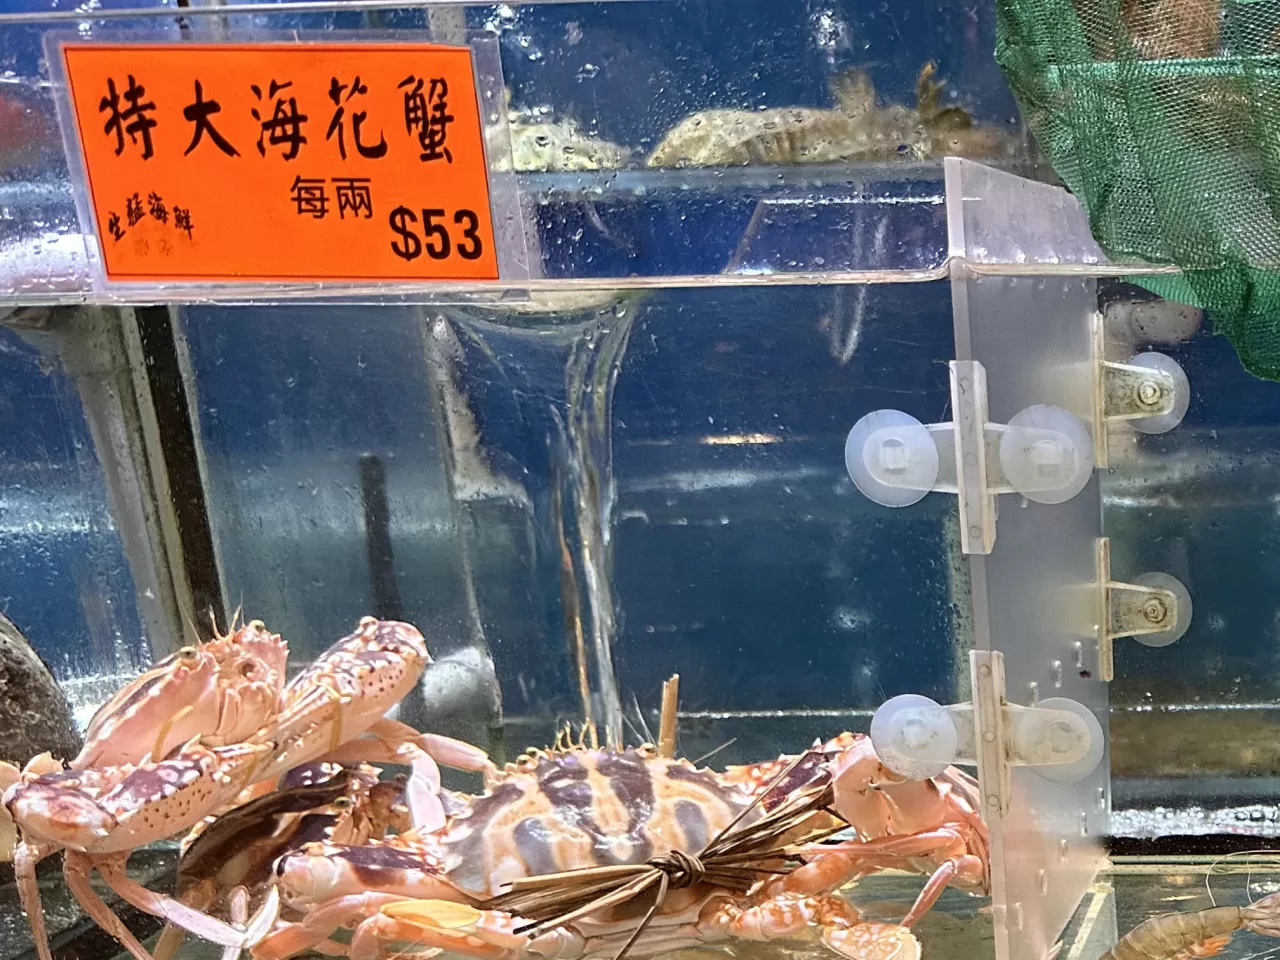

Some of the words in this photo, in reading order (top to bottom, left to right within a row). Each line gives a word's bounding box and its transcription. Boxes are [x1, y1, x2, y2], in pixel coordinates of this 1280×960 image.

[98, 74, 455, 164] 特大海花蟹
[290, 175, 373, 220] 每兩
[388, 205, 483, 262] $53
